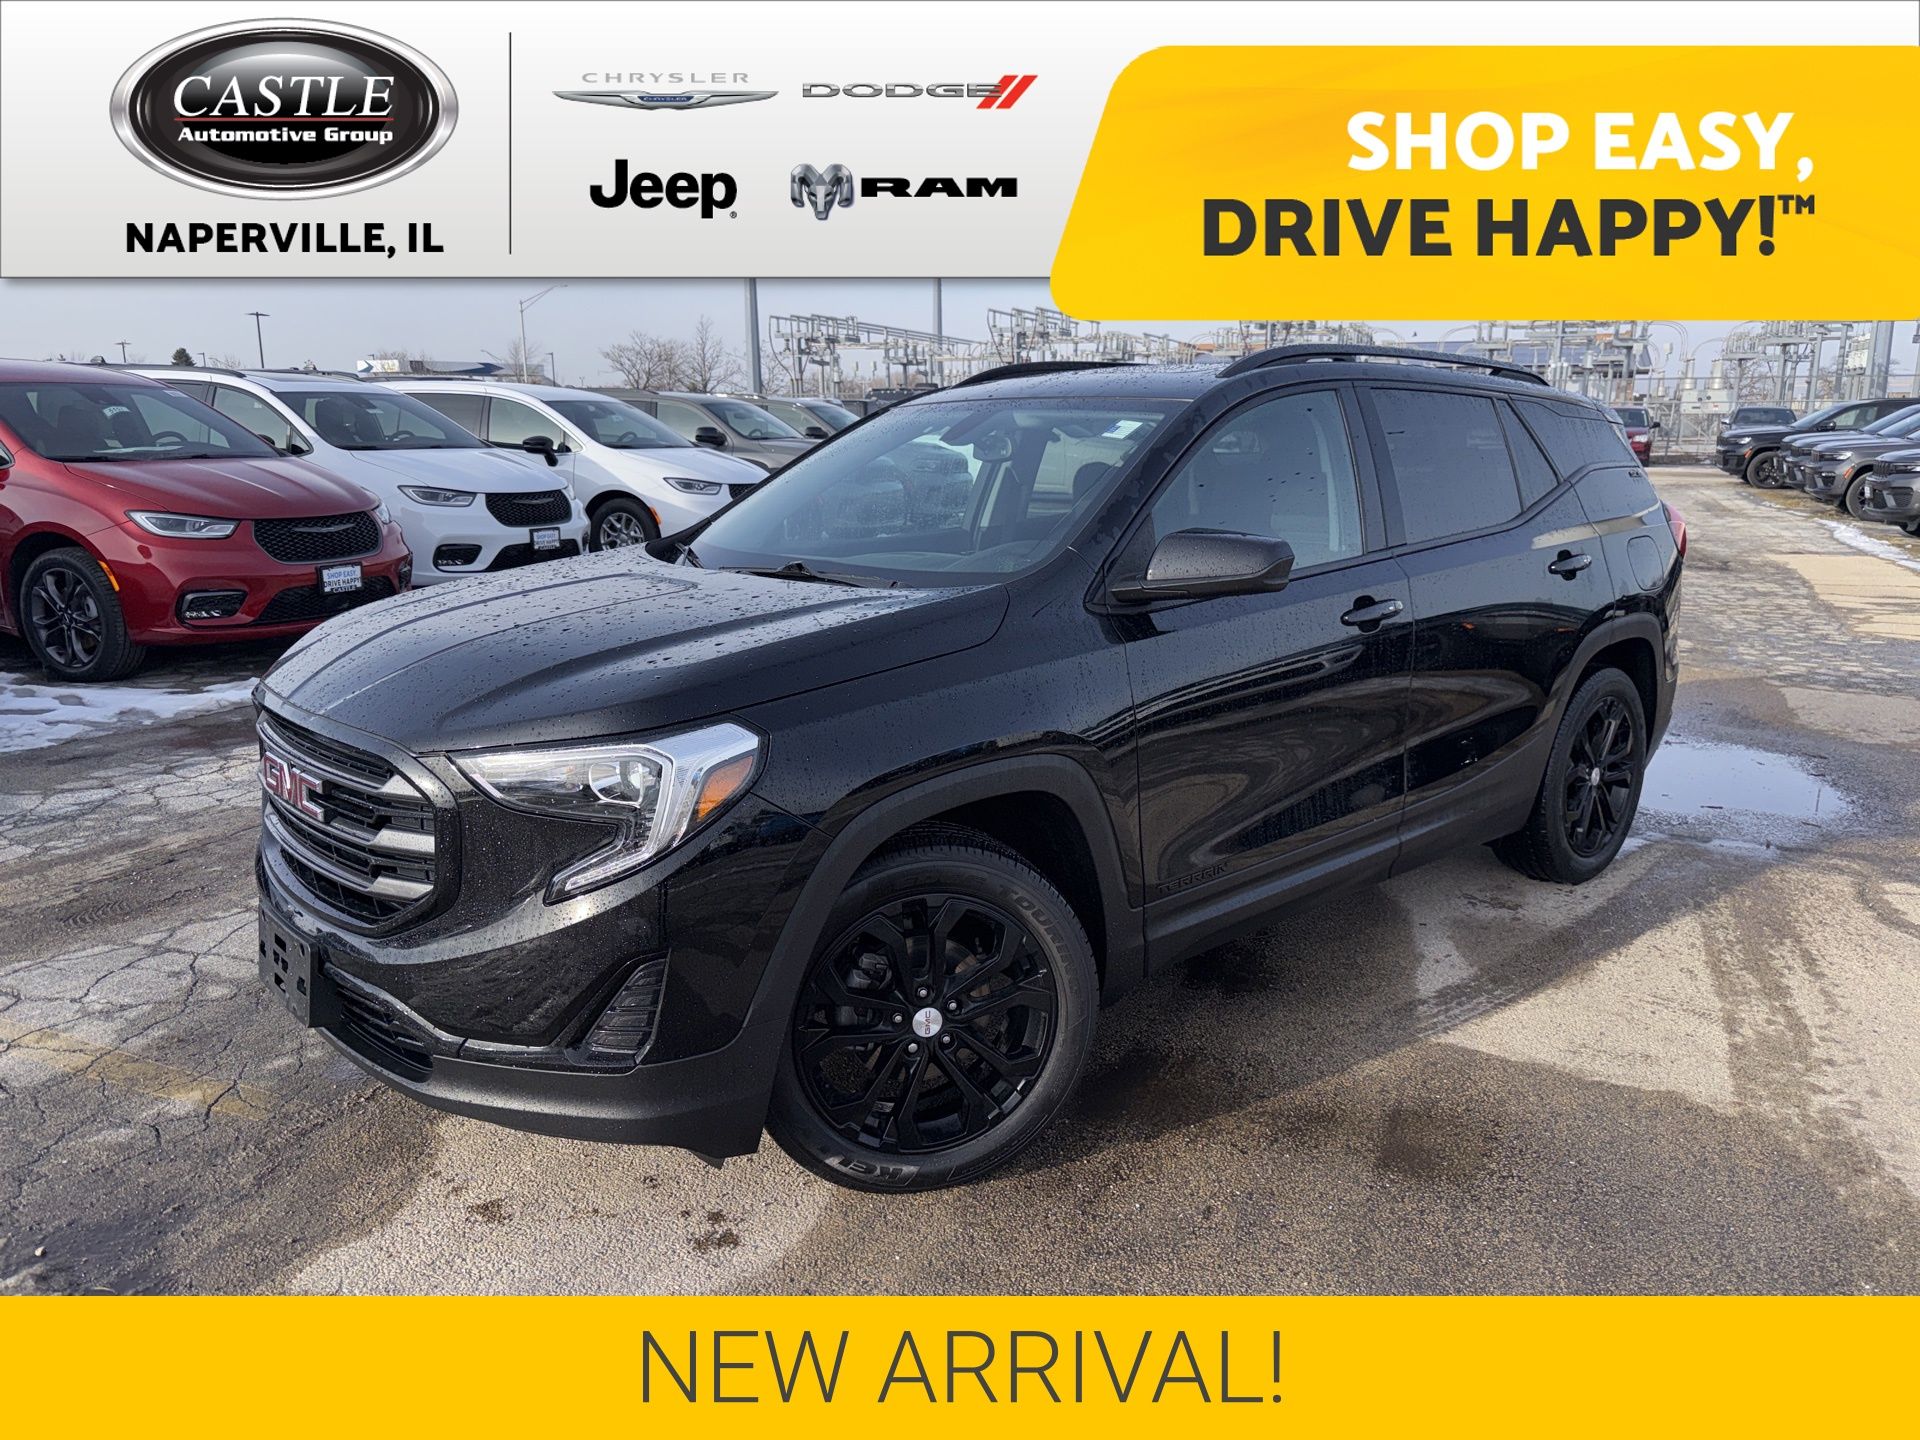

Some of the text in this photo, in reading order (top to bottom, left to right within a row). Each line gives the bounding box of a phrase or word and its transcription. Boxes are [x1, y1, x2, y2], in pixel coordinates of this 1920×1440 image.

[327, 571, 342, 580] SHOP
[324, 579, 341, 588] DRIVE
[264, 752, 324, 821] GMC
